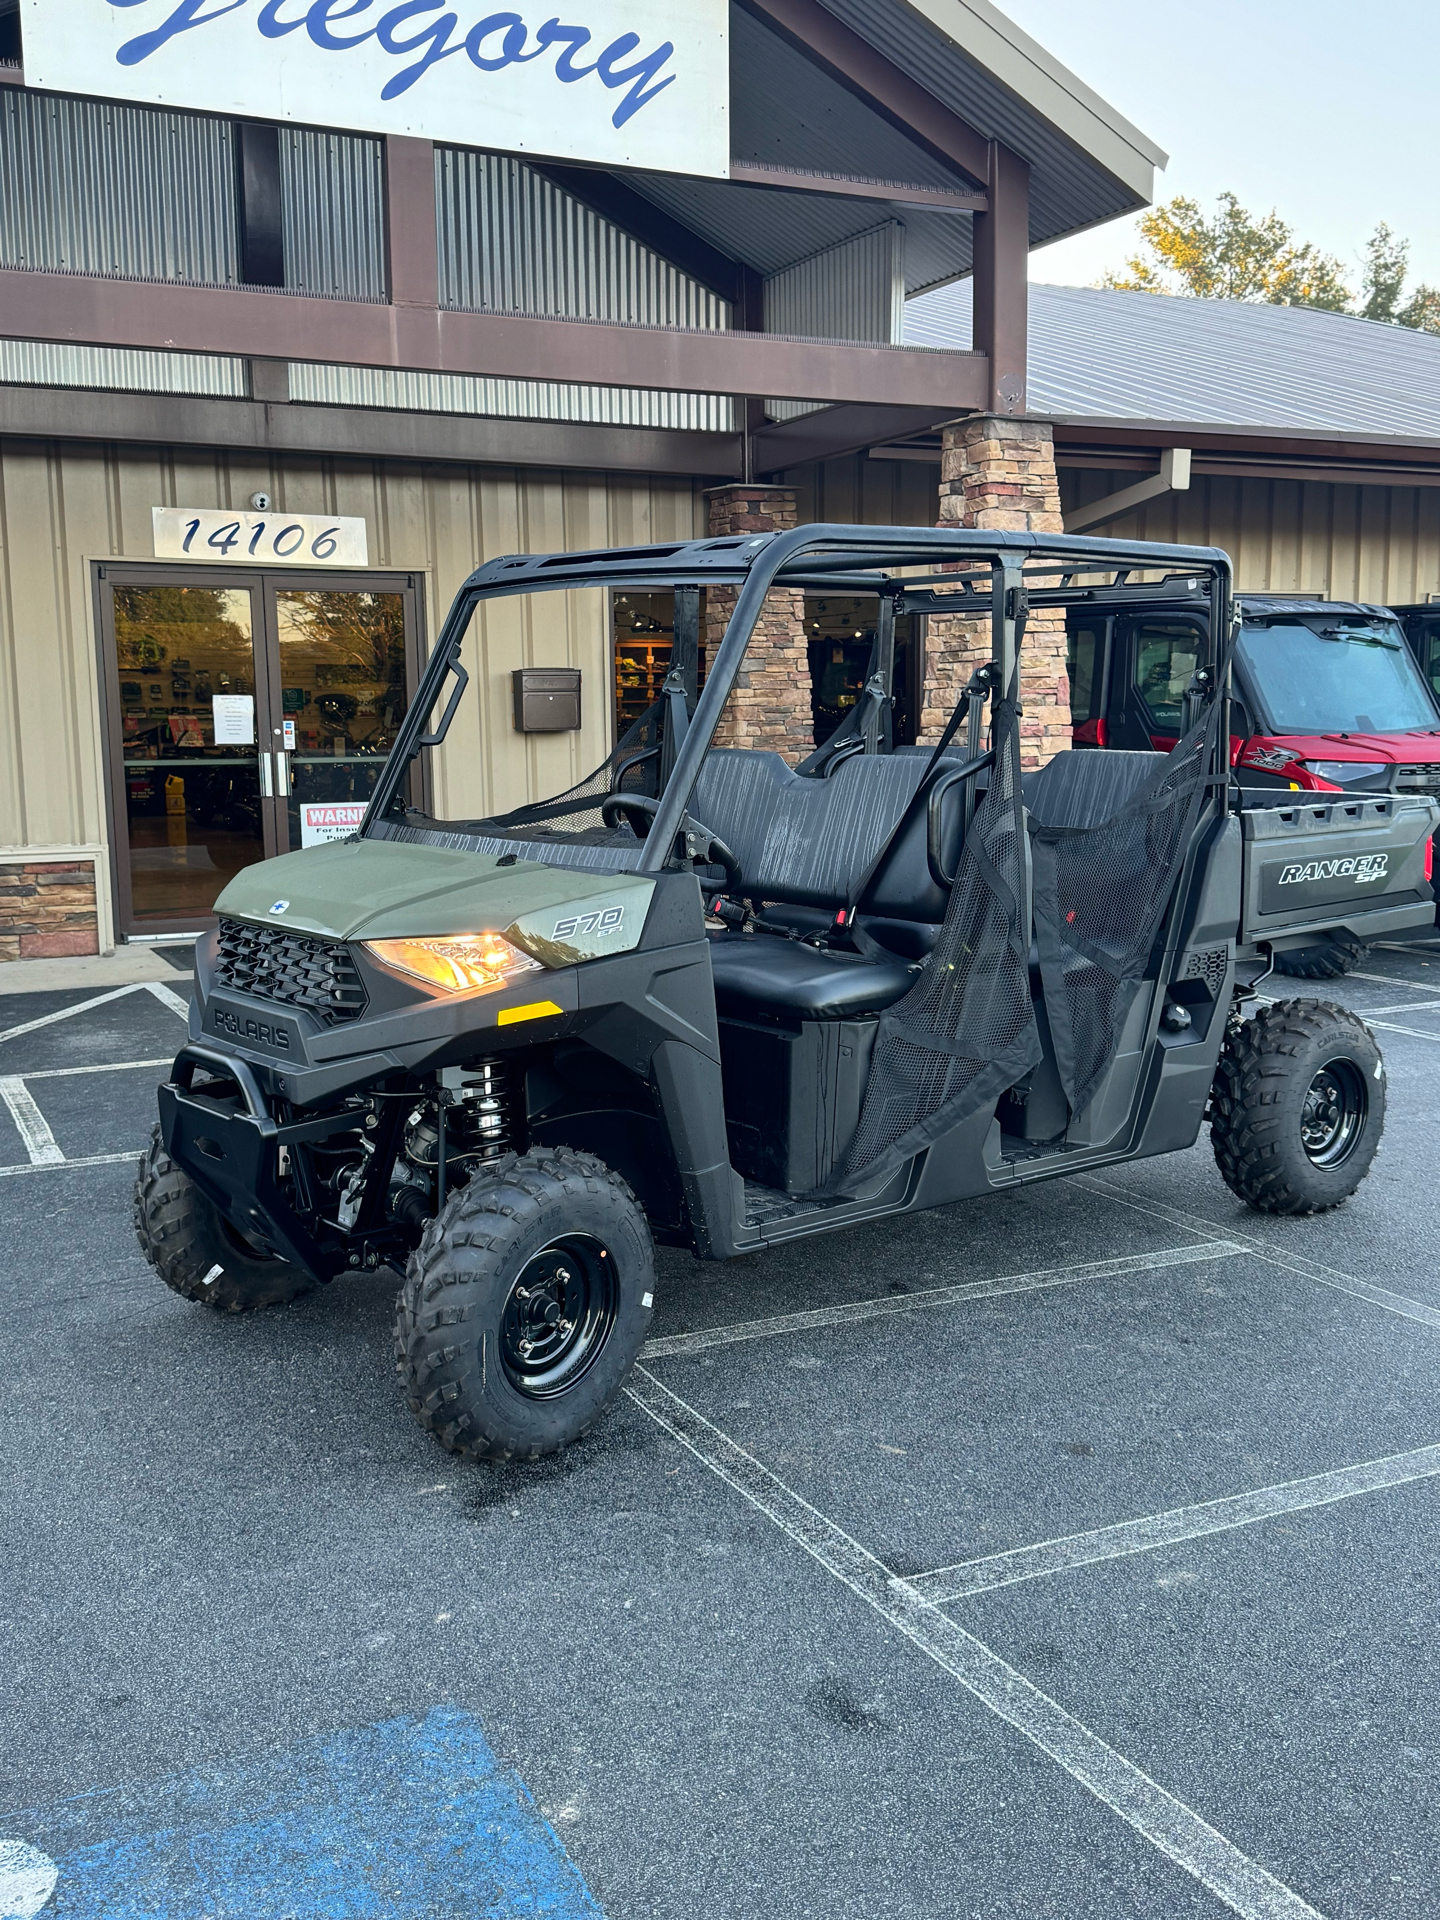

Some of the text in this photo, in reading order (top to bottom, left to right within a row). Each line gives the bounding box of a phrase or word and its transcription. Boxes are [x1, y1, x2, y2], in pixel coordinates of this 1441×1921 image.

[183, 518, 341, 560] 14106
[1246, 746, 1295, 762] XP
[1250, 757, 1285, 770] 1000
[309, 809, 365, 823] WARNI
[1278, 853, 1389, 884] RANGER
[1354, 870, 1389, 883] SP
[550, 905, 624, 942] 570
[596, 925, 624, 938] EFI
[214, 1008, 290, 1051] POLARIS
[1317, 1031, 1360, 1049] CARLSTAR
